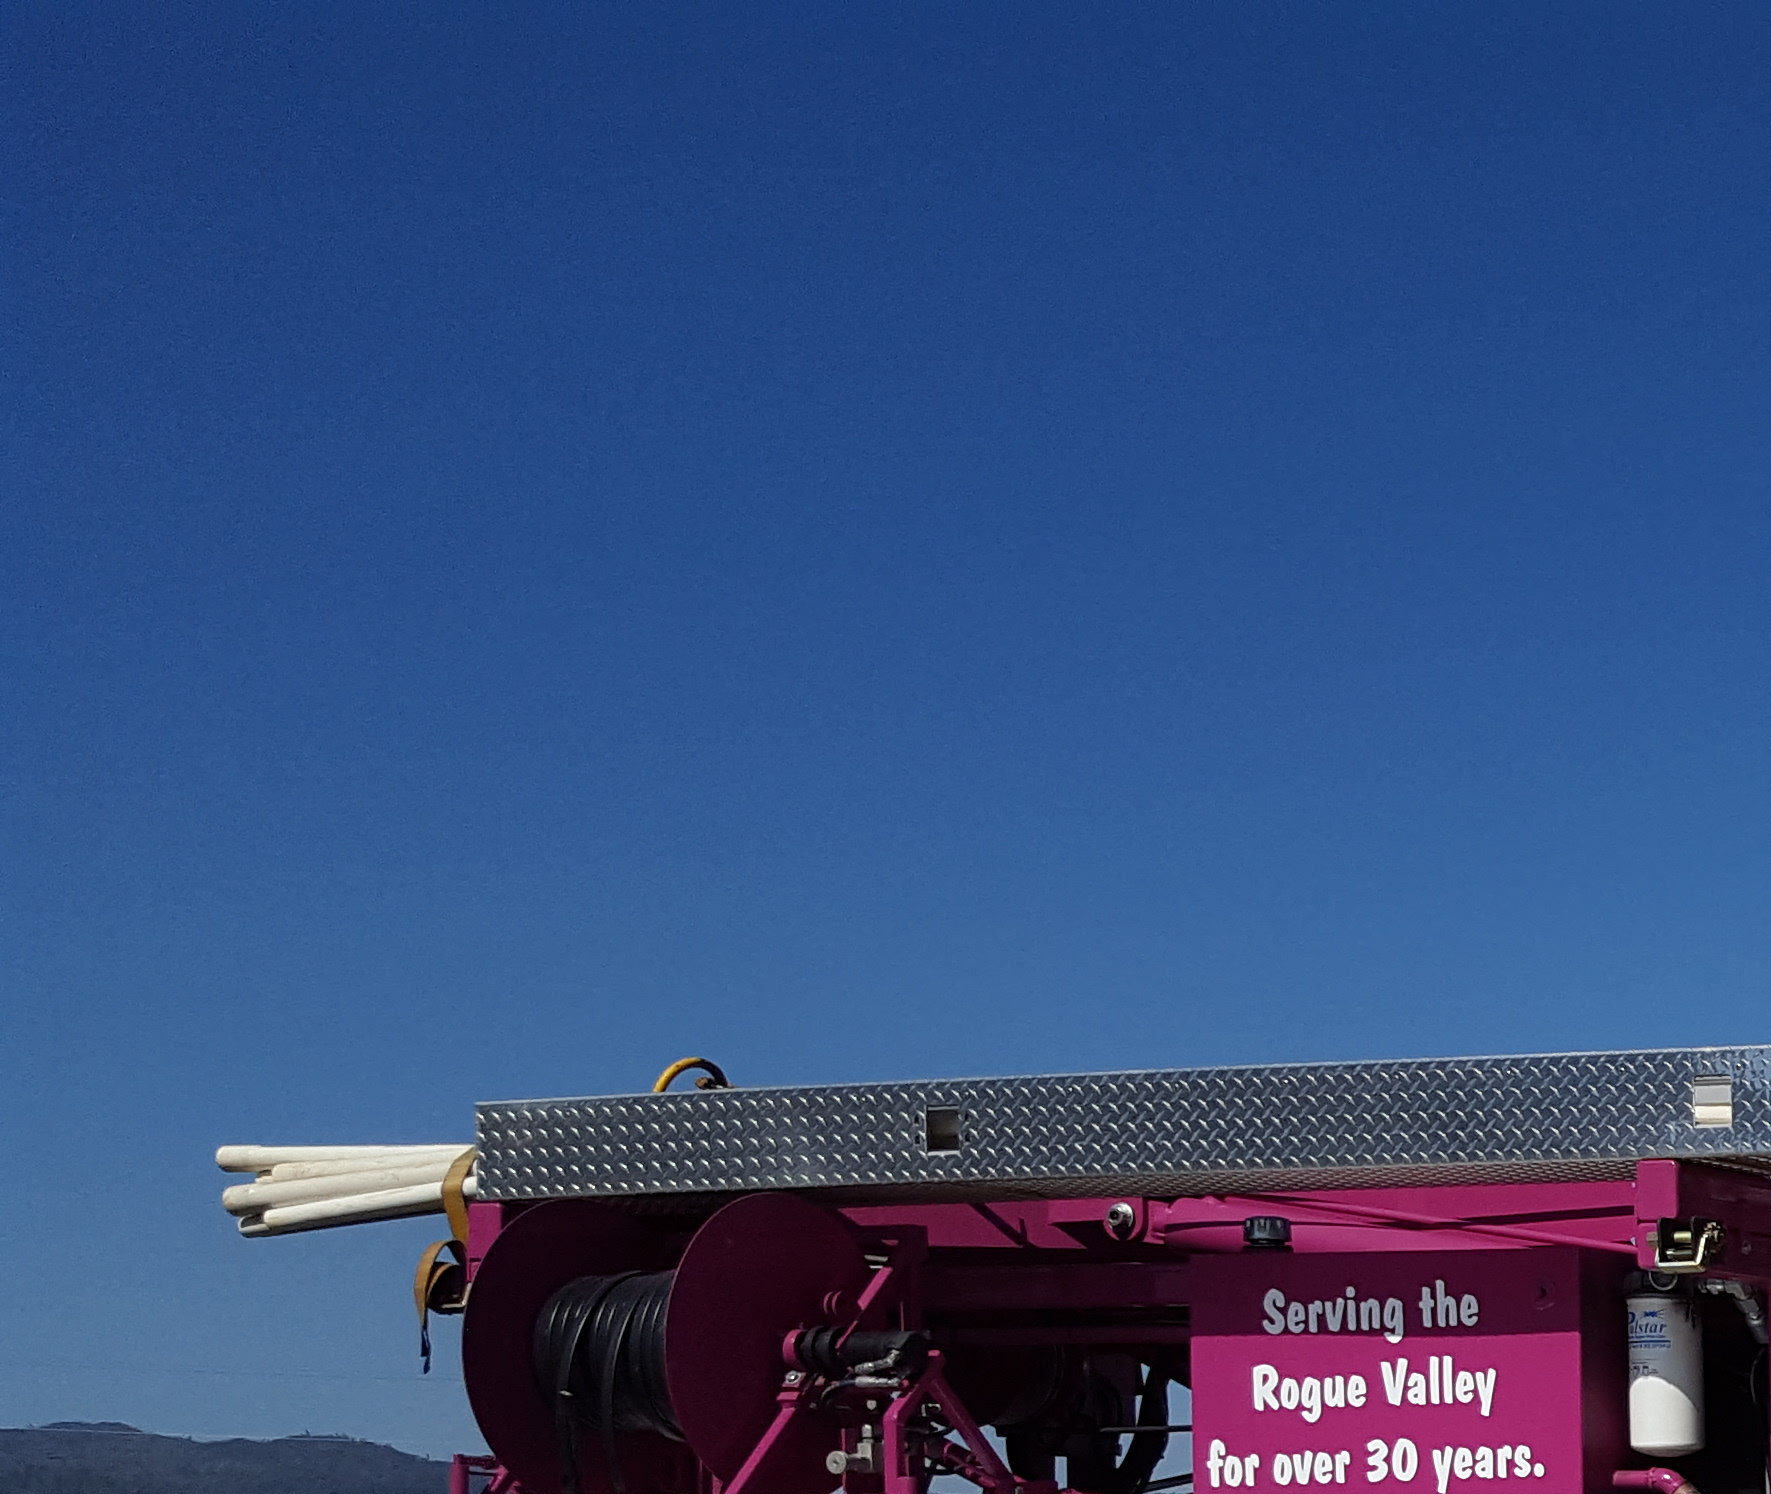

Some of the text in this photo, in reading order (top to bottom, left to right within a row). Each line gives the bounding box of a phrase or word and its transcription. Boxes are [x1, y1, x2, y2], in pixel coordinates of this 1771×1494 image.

[1262, 1279, 1480, 1343] Serving the
[1252, 1355, 1497, 1423] Rogue Valley
[1206, 1437, 1546, 1494] for over 30 years.
